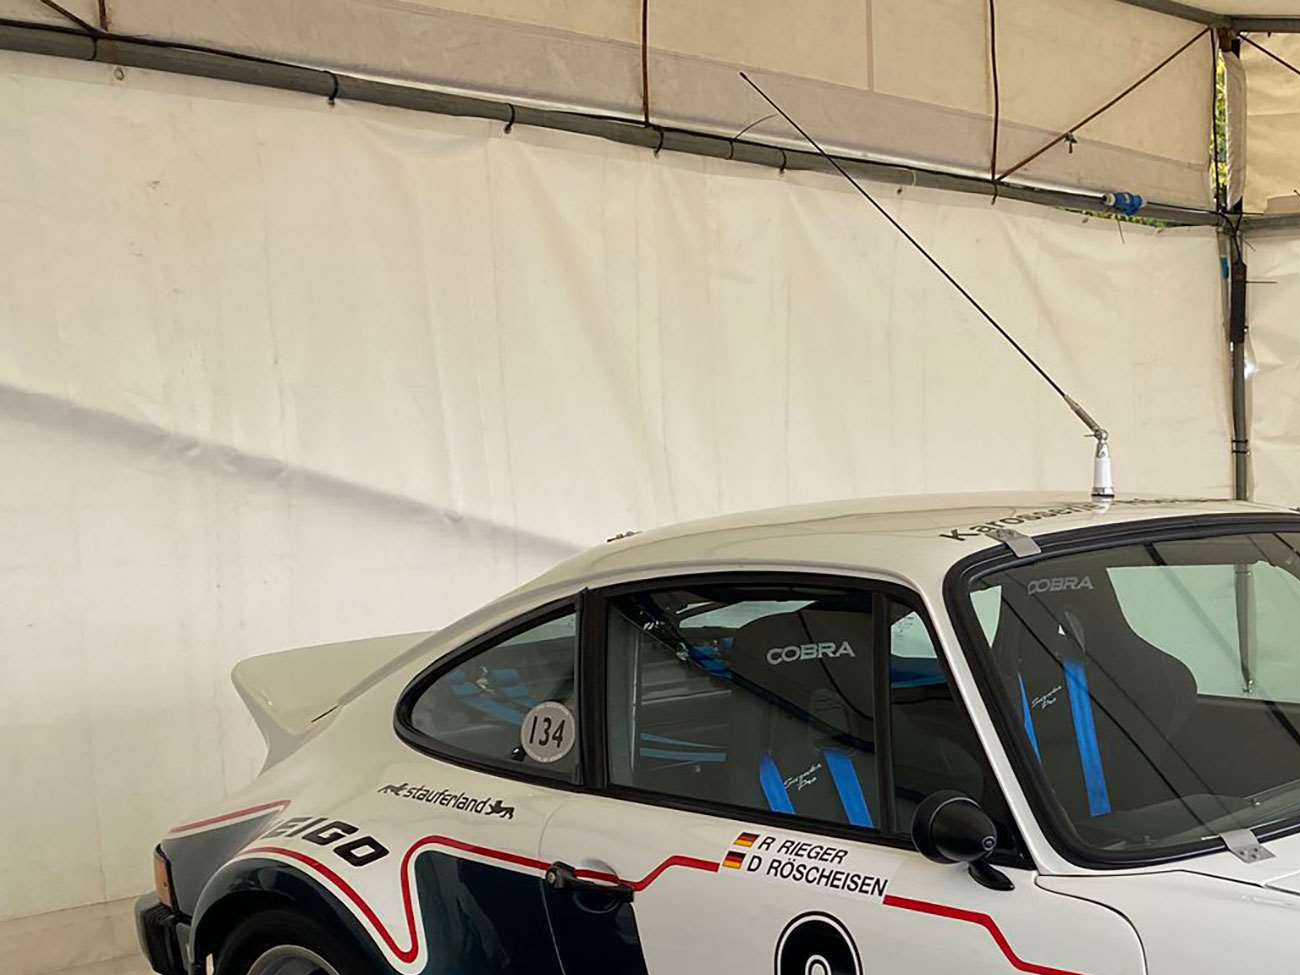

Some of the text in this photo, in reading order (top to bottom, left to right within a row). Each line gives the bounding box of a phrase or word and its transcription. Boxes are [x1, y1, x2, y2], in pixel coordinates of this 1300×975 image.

[1027, 575, 1094, 595] COBRA
[766, 640, 856, 666] COBRA
[529, 715, 566, 749] 134
[402, 784, 493, 815] stauferland
[257, 815, 390, 867] EIGO
[758, 836, 849, 865] R RIEGER
[747, 855, 889, 897] D RÖSCHEISEN
